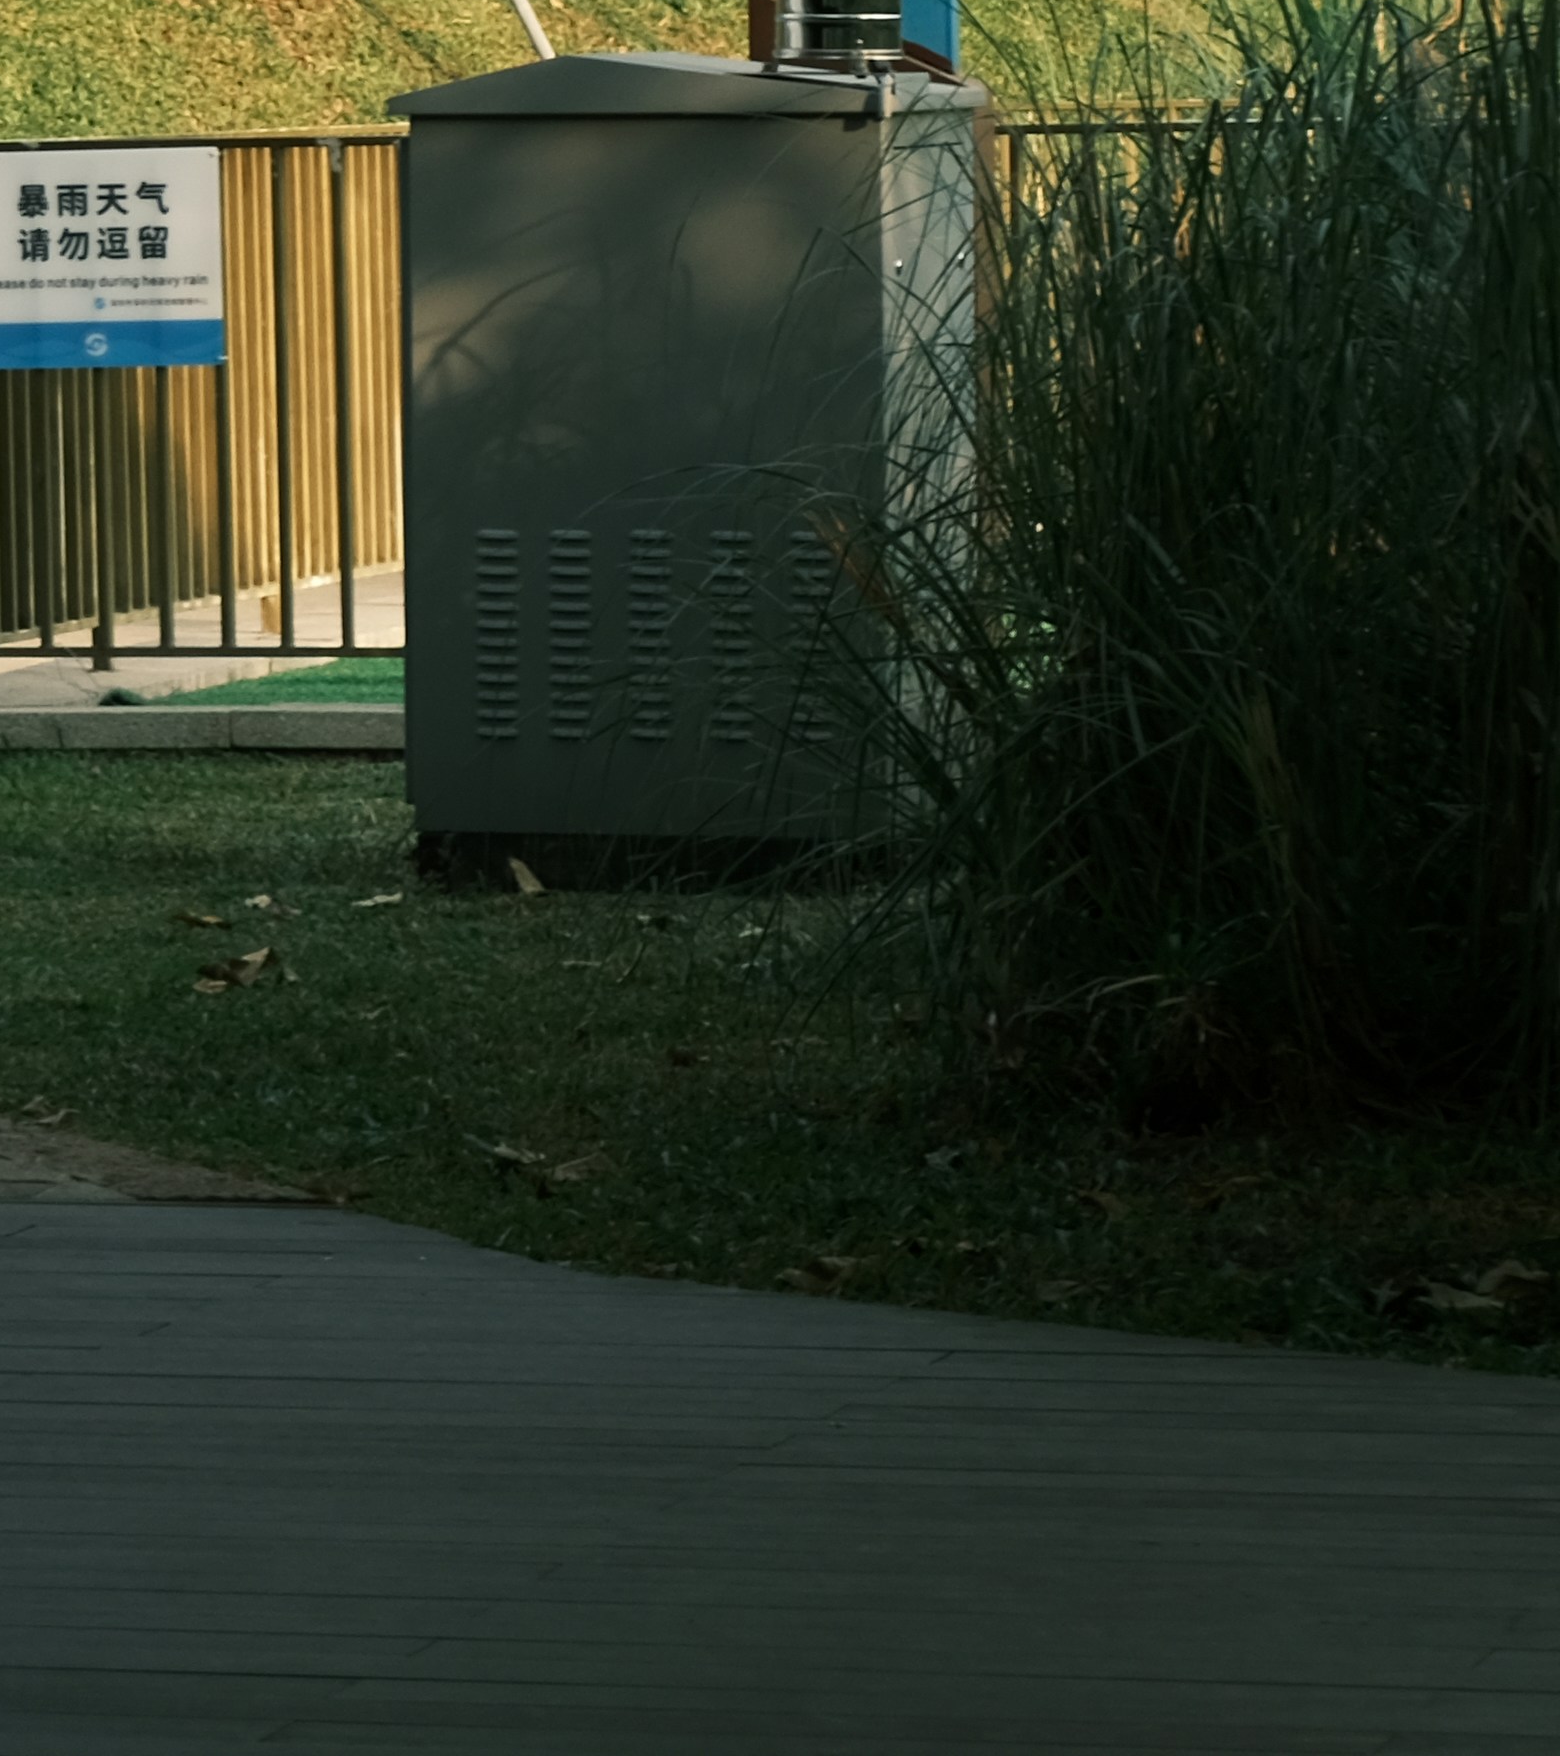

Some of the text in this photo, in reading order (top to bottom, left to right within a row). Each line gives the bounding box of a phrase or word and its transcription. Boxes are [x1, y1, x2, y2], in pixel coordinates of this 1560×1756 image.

[17, 181, 169, 218] 暴雨天气
[17, 226, 169, 262] 请勿逗留
[29, 278, 44, 289] do
[47, 278, 67, 288] not
[70, 277, 96, 290] stay
[98, 276, 139, 289] during
[142, 275, 179, 288] heavy
[182, 275, 208, 286] rain
